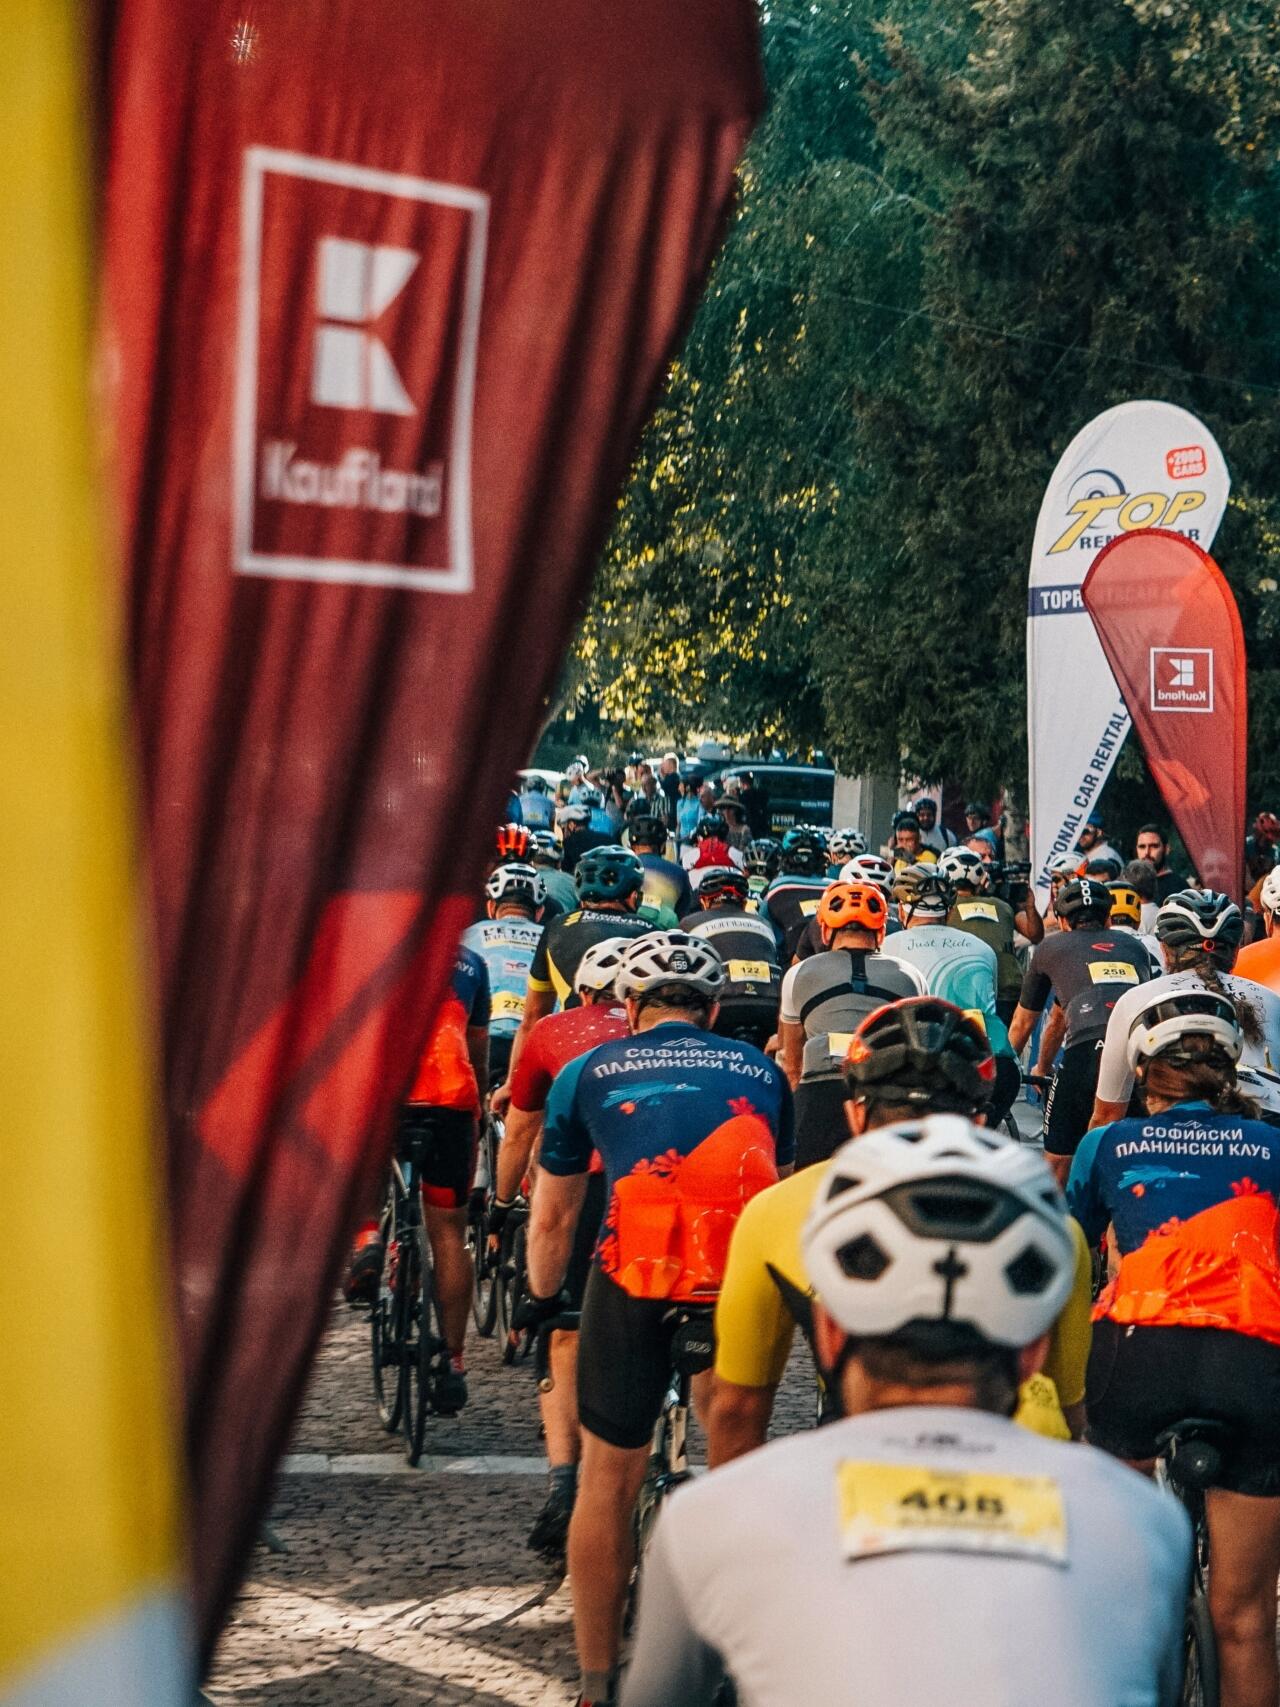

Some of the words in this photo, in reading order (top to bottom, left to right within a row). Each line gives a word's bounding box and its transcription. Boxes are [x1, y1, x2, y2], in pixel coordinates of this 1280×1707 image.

[262, 440, 443, 517] Kaufland
[1046, 490, 1207, 556] TOP
[1073, 774, 1100, 809] CAR
[1089, 712, 1129, 773] RENTAL
[907, 939, 937, 951] Just
[1103, 968, 1127, 976] 258
[625, 1048, 744, 1061] СОФИЙСКИ
[593, 1057, 724, 1079] ПЛАНИНСКИ
[728, 1061, 773, 1085] КЛУБ
[1142, 1126, 1243, 1141] СОФИЙСКИ
[1116, 1140, 1224, 1158] ПЛАНИНСКИ
[1229, 1143, 1271, 1160] КЛУБ
